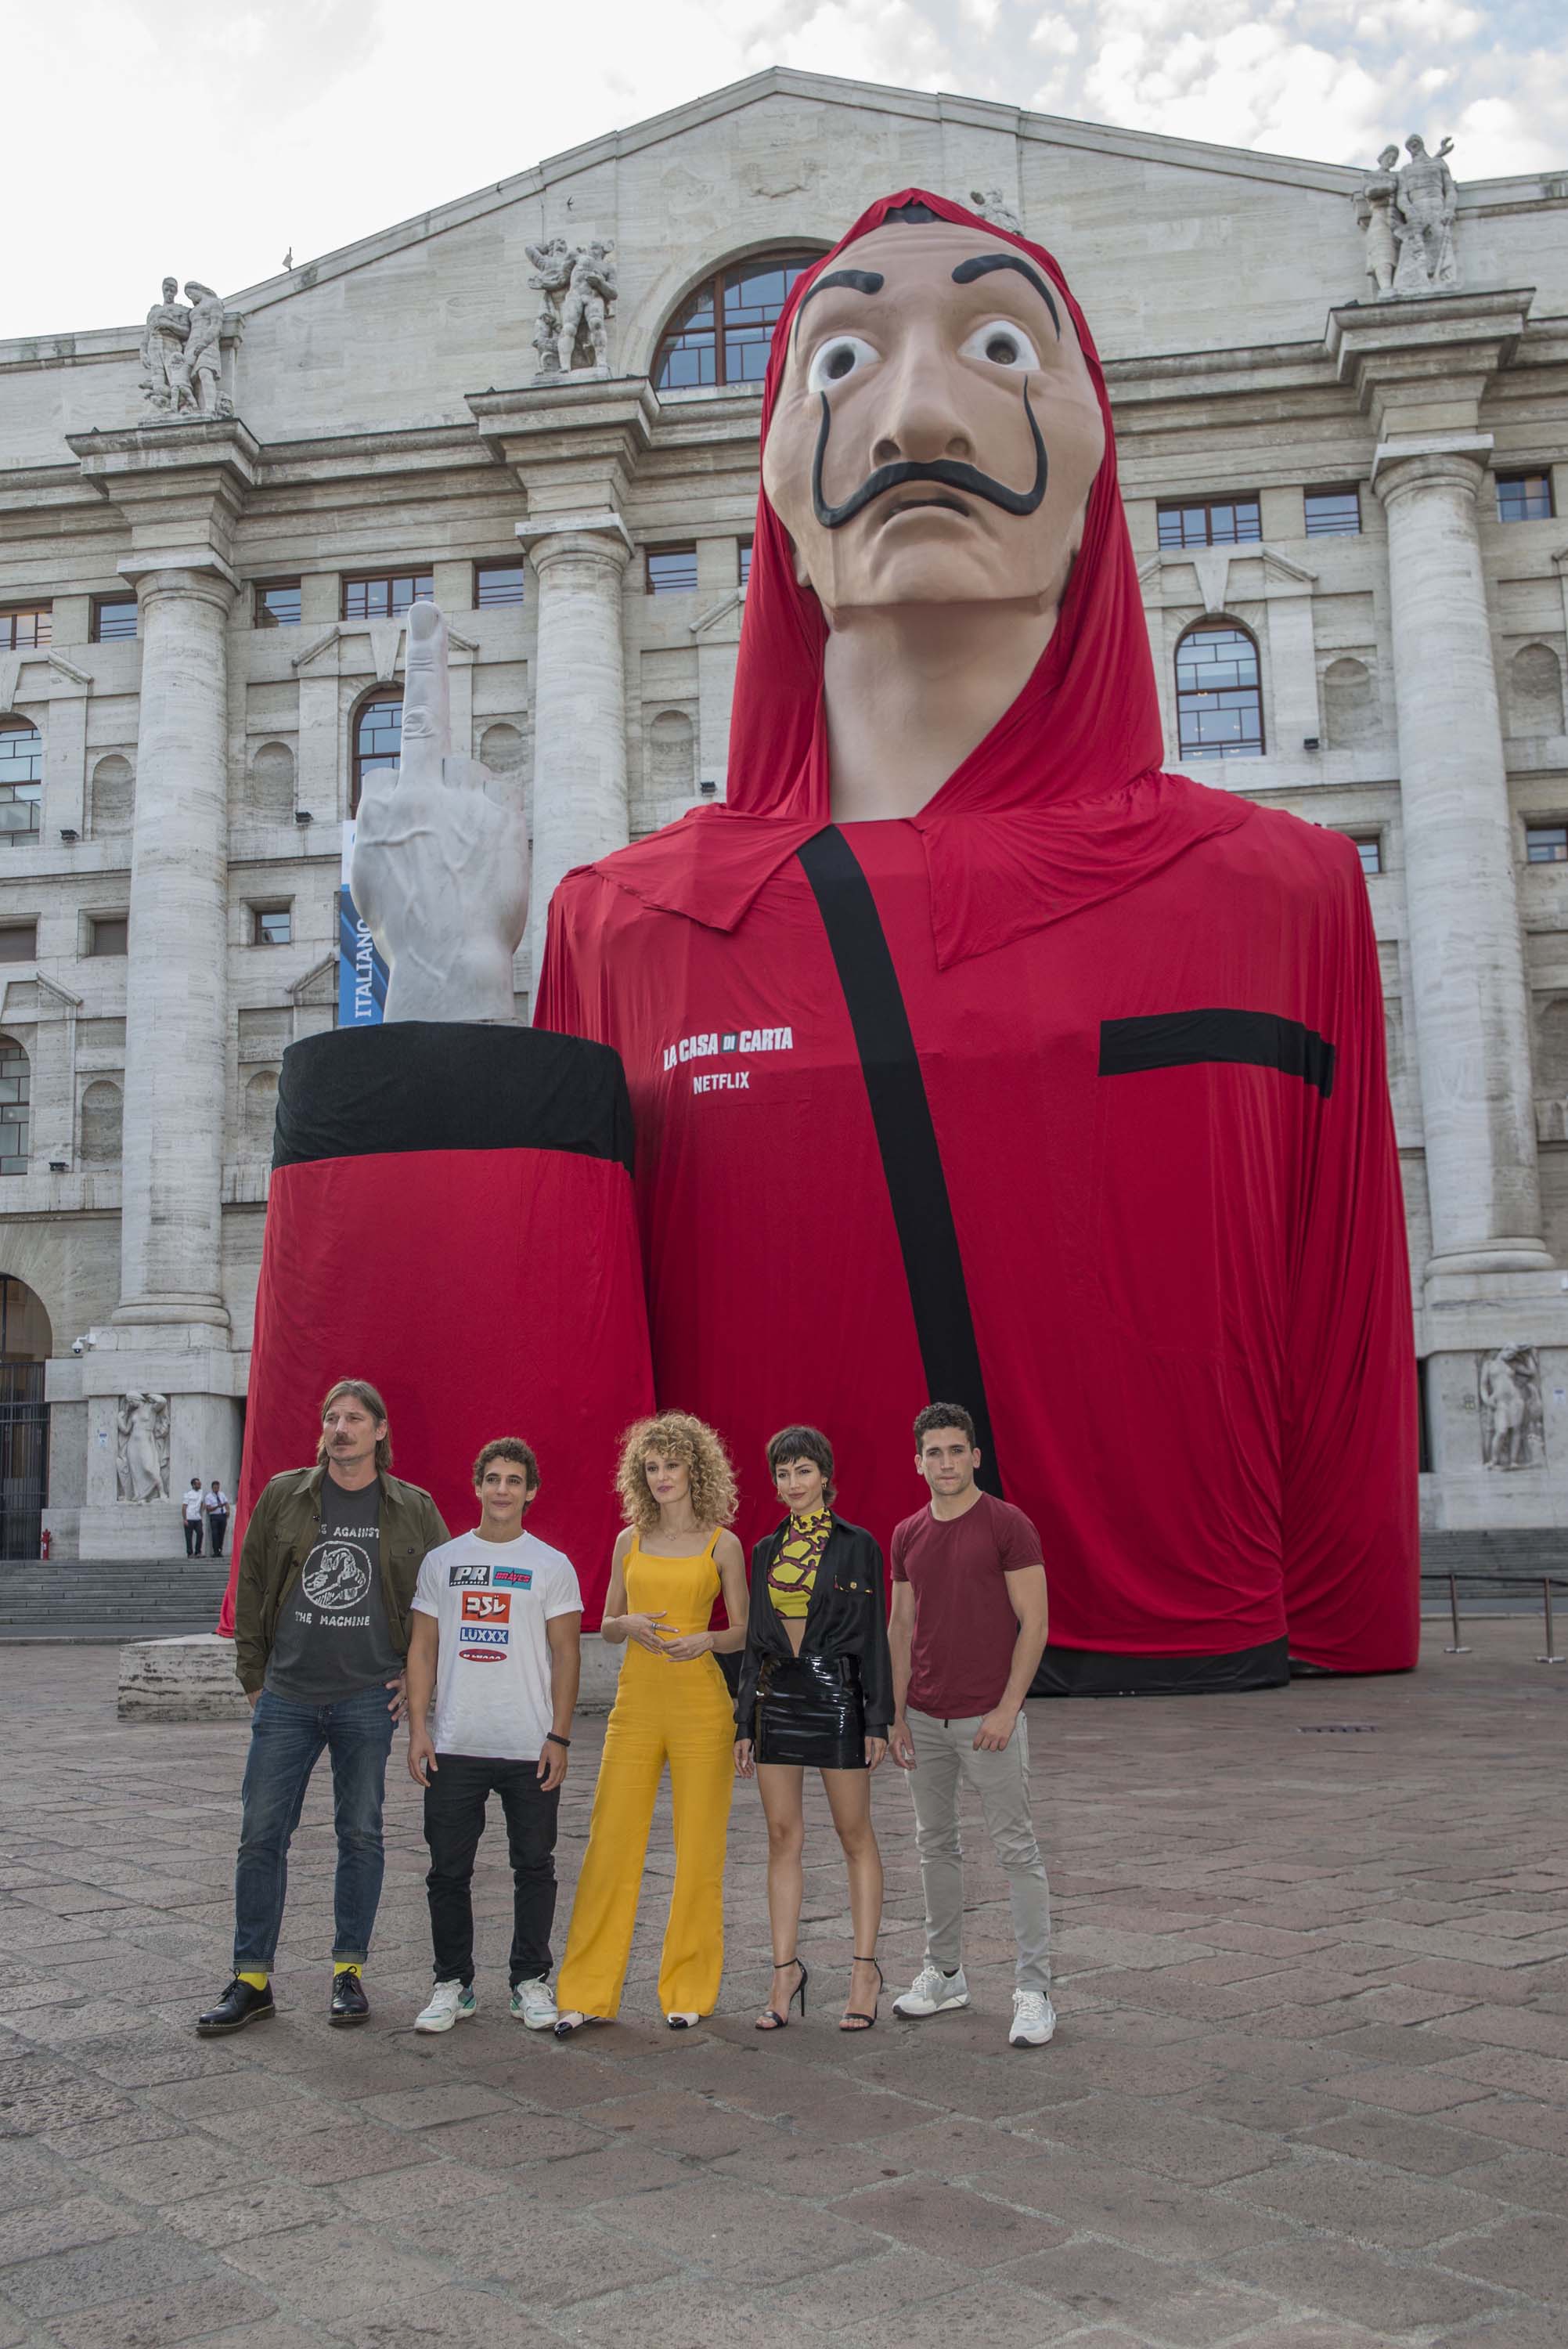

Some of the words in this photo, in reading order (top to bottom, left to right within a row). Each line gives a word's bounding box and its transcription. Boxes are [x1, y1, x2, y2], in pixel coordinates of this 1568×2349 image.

[663, 1044, 678, 1072] LA
[679, 1033, 719, 1063] CASA
[723, 1034, 736, 1051] DI
[739, 1027, 793, 1053] CARTA
[693, 1071, 750, 1095] NETFLIX
[333, 1527, 380, 1539] AGAINST
[454, 1566, 488, 1581] PR
[294, 1611, 312, 1625] THE
[319, 1615, 370, 1627] MACHINE
[461, 1628, 507, 1643] LUXXX
